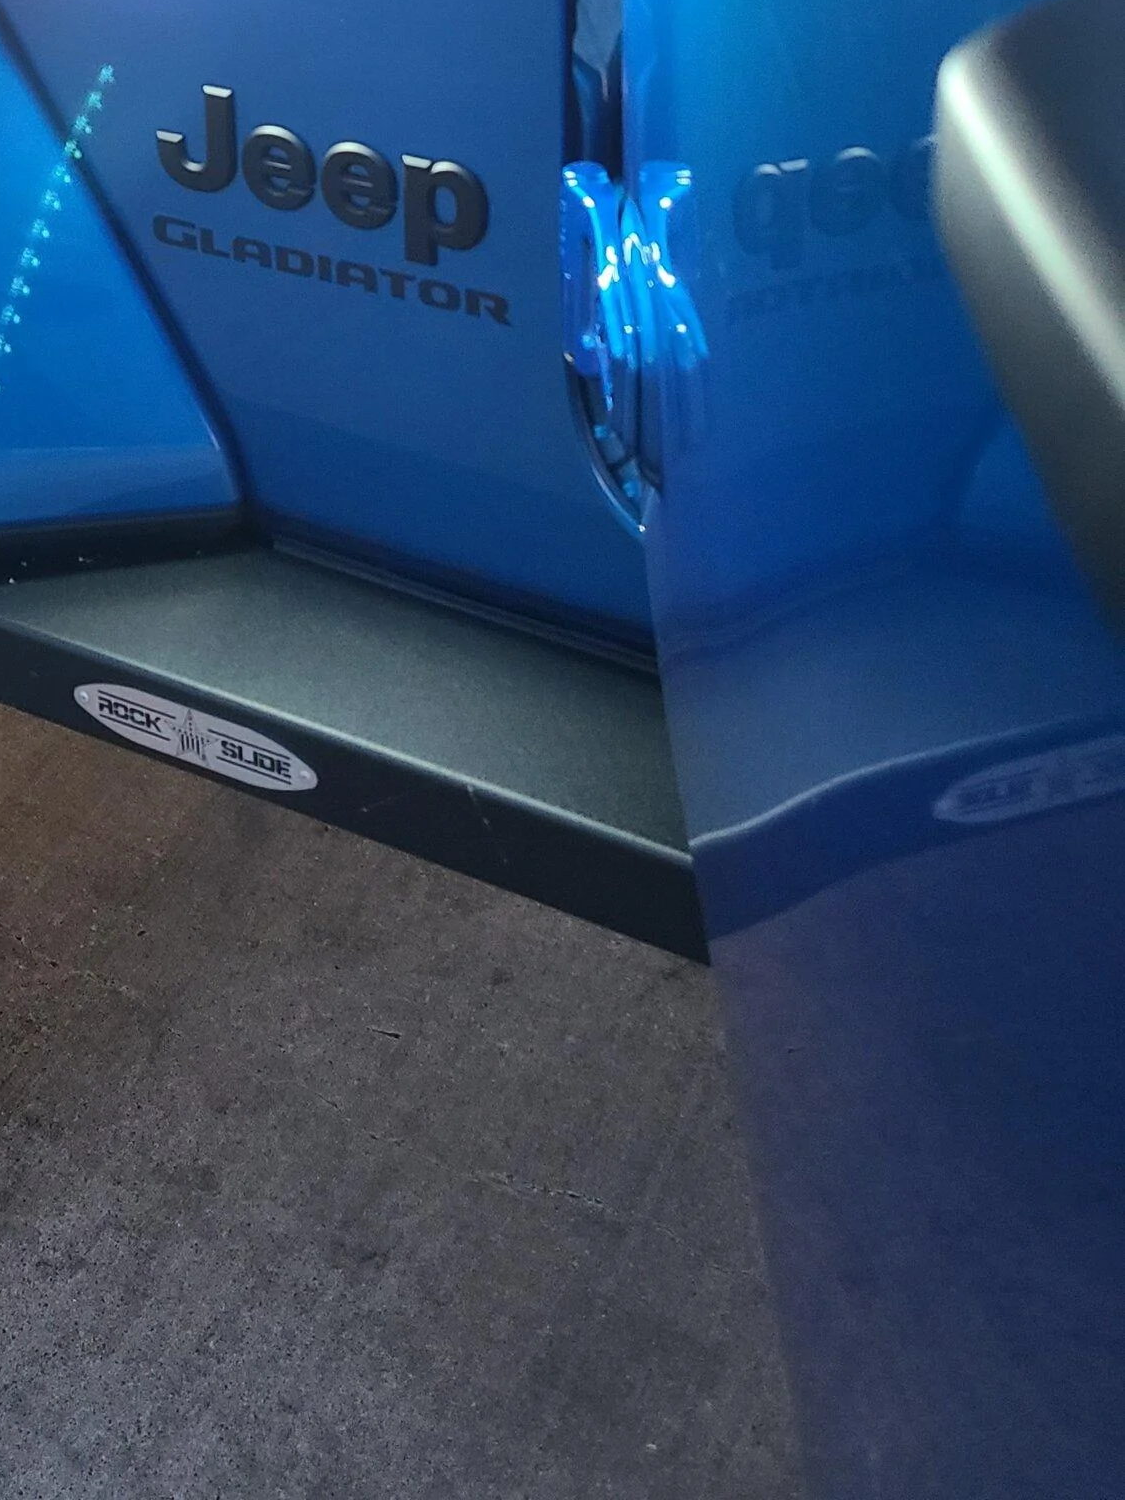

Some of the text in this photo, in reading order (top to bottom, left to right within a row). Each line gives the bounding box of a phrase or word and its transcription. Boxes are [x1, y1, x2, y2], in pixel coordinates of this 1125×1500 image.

[155, 83, 490, 266] Jeep
[152, 214, 512, 326] GLADIATOR
[98, 695, 293, 779] ROCK SLIDE
